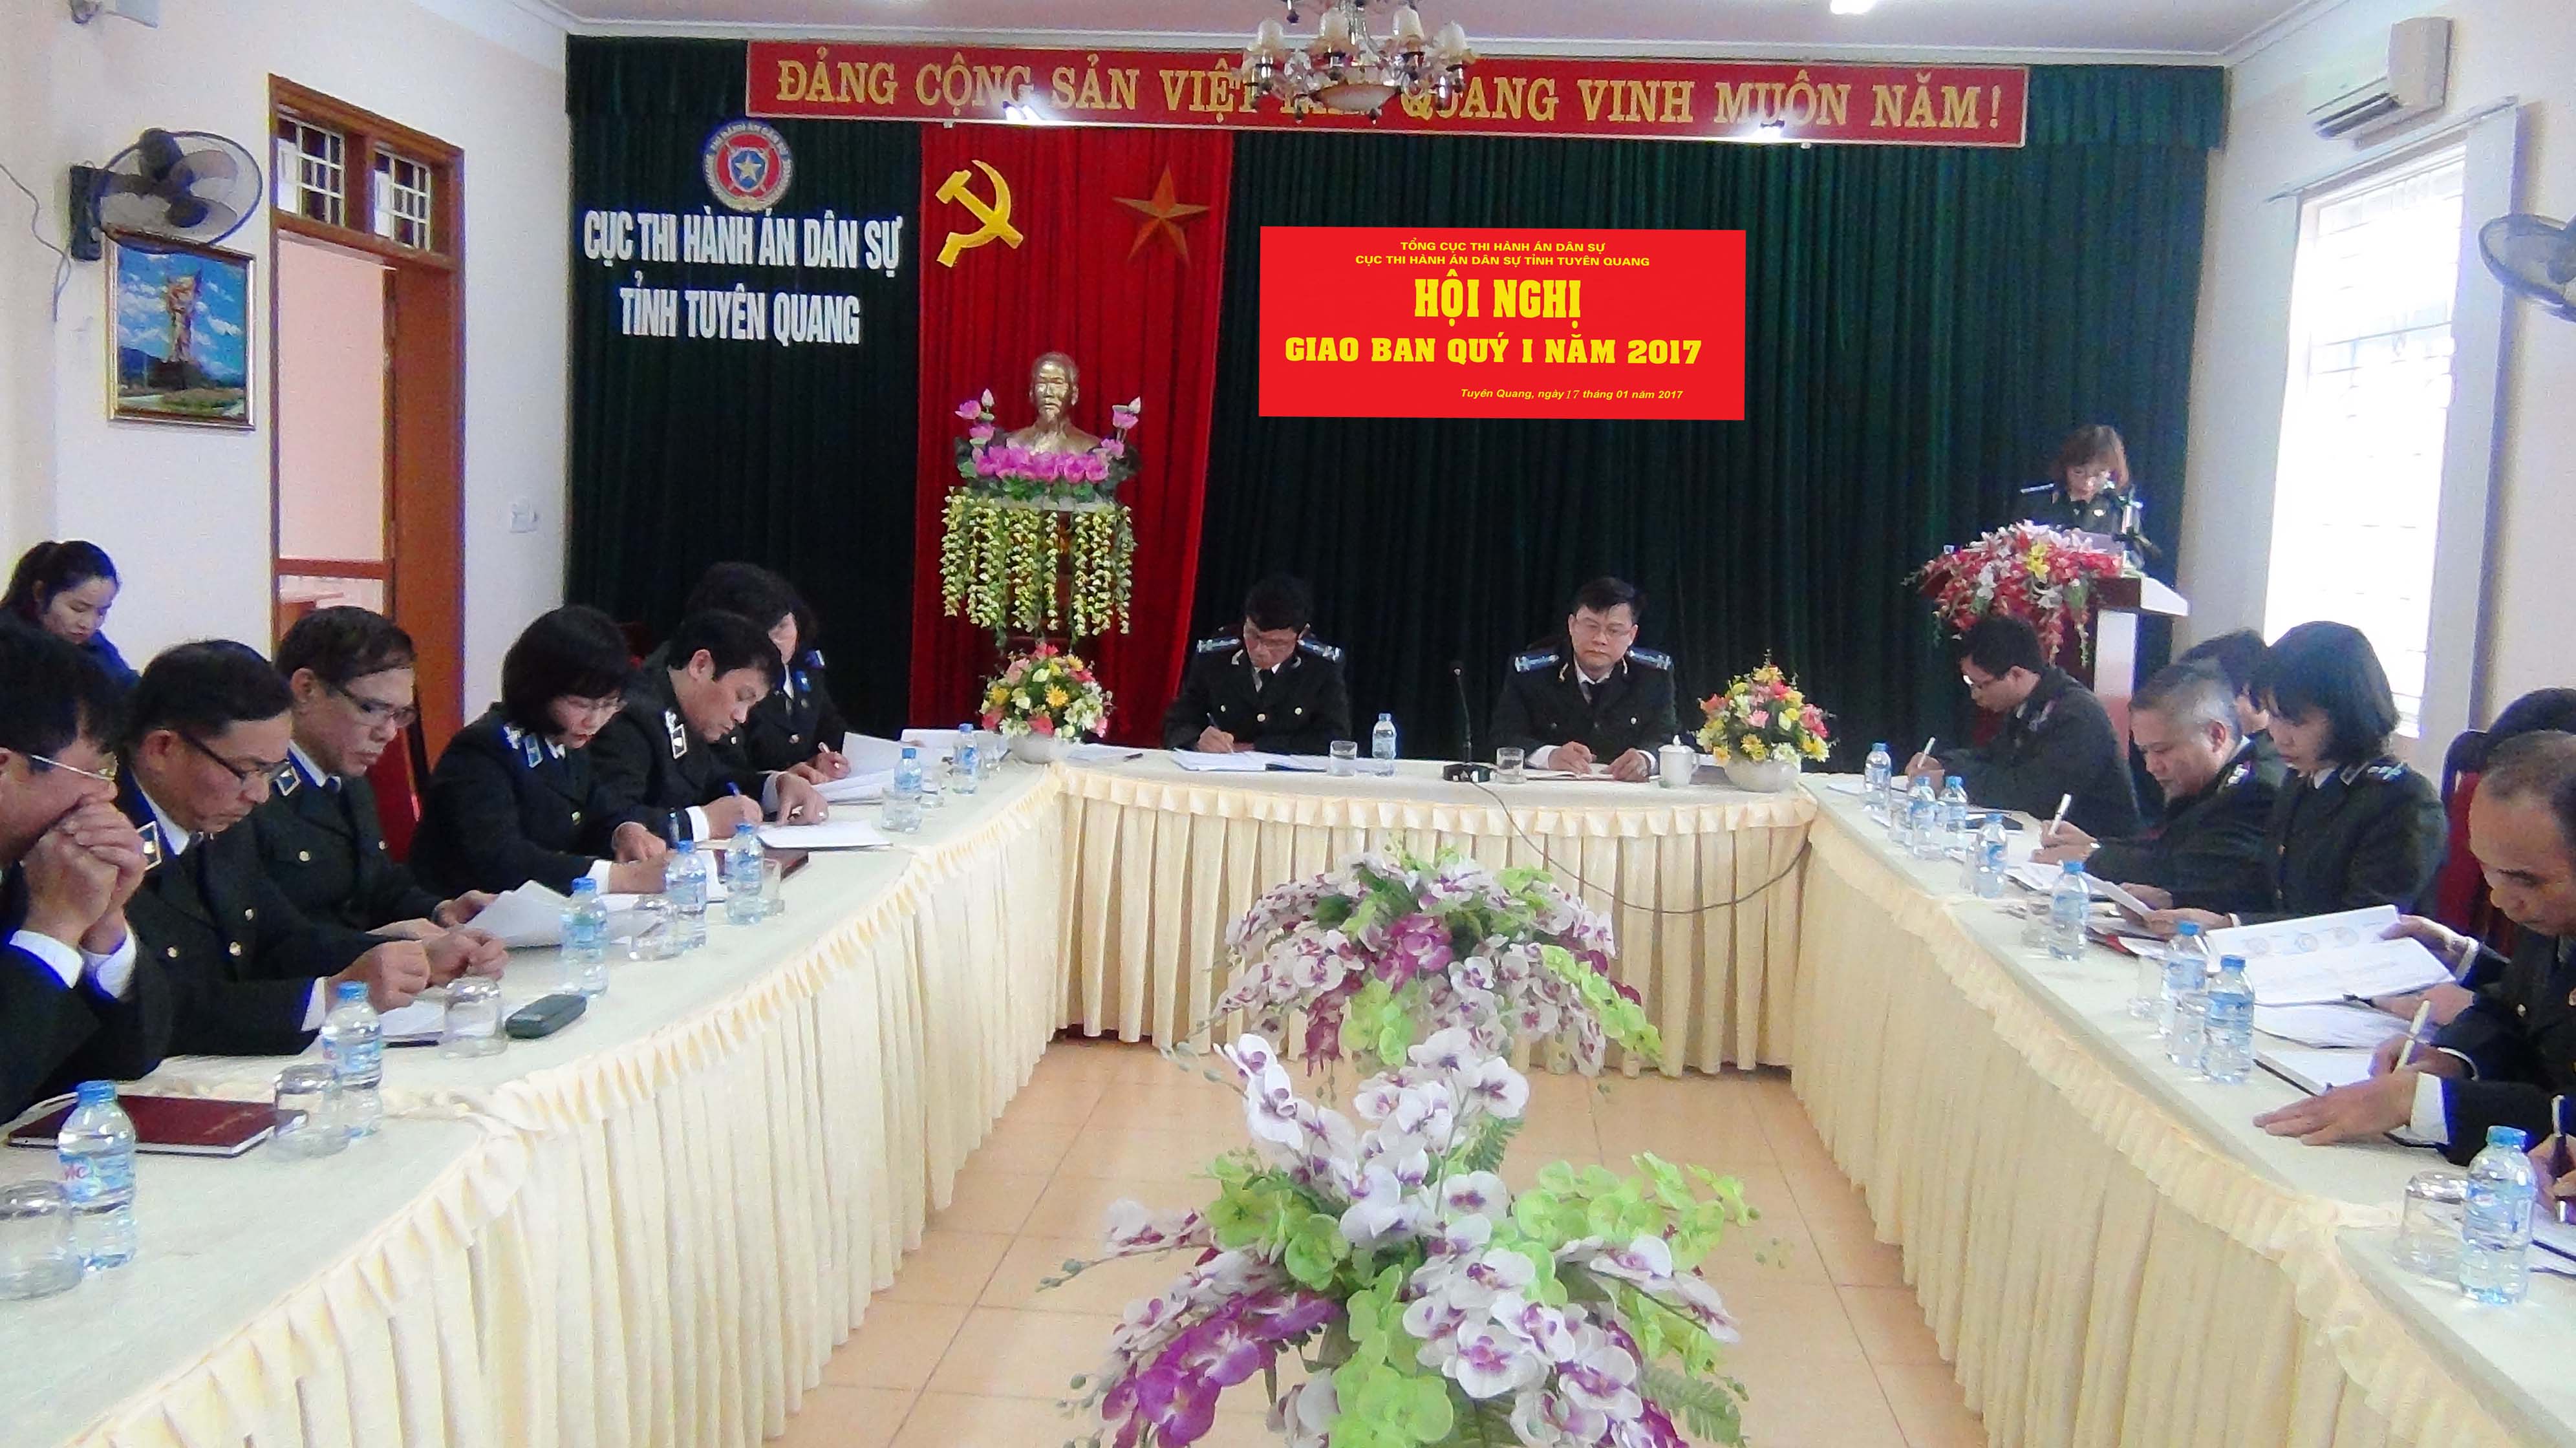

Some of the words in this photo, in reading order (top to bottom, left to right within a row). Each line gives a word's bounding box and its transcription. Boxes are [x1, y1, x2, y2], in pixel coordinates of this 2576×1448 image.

[777, 47, 898, 103] ĐẢNG
[915, 51, 1035, 116] CỘNG
[1050, 54, 1139, 110] SẢN
[1577, 78, 1694, 123] VINH
[1713, 69, 1851, 127] MUÔN
[584, 211, 634, 268] CỤC
[638, 212, 678, 262] THI
[683, 205, 754, 265] HÀNH
[758, 208, 796, 267] ÁN
[804, 209, 858, 269] DÂN
[864, 215, 903, 278] SỰ
[1355, 255, 1382, 267] CỤC
[1386, 255, 1406, 264] THI
[1410, 253, 1445, 265] HÀNH
[1449, 254, 1468, 265] ÁN
[1472, 254, 1499, 266] DÂN
[1503, 255, 1521, 268] SỰ
[1525, 253, 1554, 266] TỈNH
[1557, 255, 1600, 266] TUYÊN
[1604, 257, 1649, 267] QUANG
[1401, 237, 1436, 251] TỔNG
[1439, 242, 1466, 253] CỤC
[1470, 242, 1490, 251] THI
[1494, 240, 1530, 251] HÀNH
[1533, 240, 1552, 251] ÁN
[1556, 241, 1583, 252] DÂN
[1587, 242, 1605, 255] SỰ
[619, 270, 678, 337] TỈNH
[685, 282, 766, 341] TUYÊN
[773, 292, 861, 347] QUANG
[1415, 268, 1479, 327] HỘI
[1493, 279, 1581, 328] NGHỊ
[1285, 337, 1359, 362] GIAO
[1371, 338, 1436, 362] BAN
[1447, 332, 1509, 365] QUÝ
[1522, 339, 1533, 363] I
[1545, 334, 1616, 364] NĂM
[1627, 339, 1702, 365] 2017
[1461, 389, 1493, 399] Tuyên
[1496, 390, 1534, 399] Quang,
[1538, 390, 1565, 400] ngày
[1566, 390, 1580, 399] 17
[1583, 390, 1613, 401] tháng
[1616, 390, 1628, 399] 01
[1631, 390, 1655, 399] năm
[1658, 390, 1684, 399] 2017
